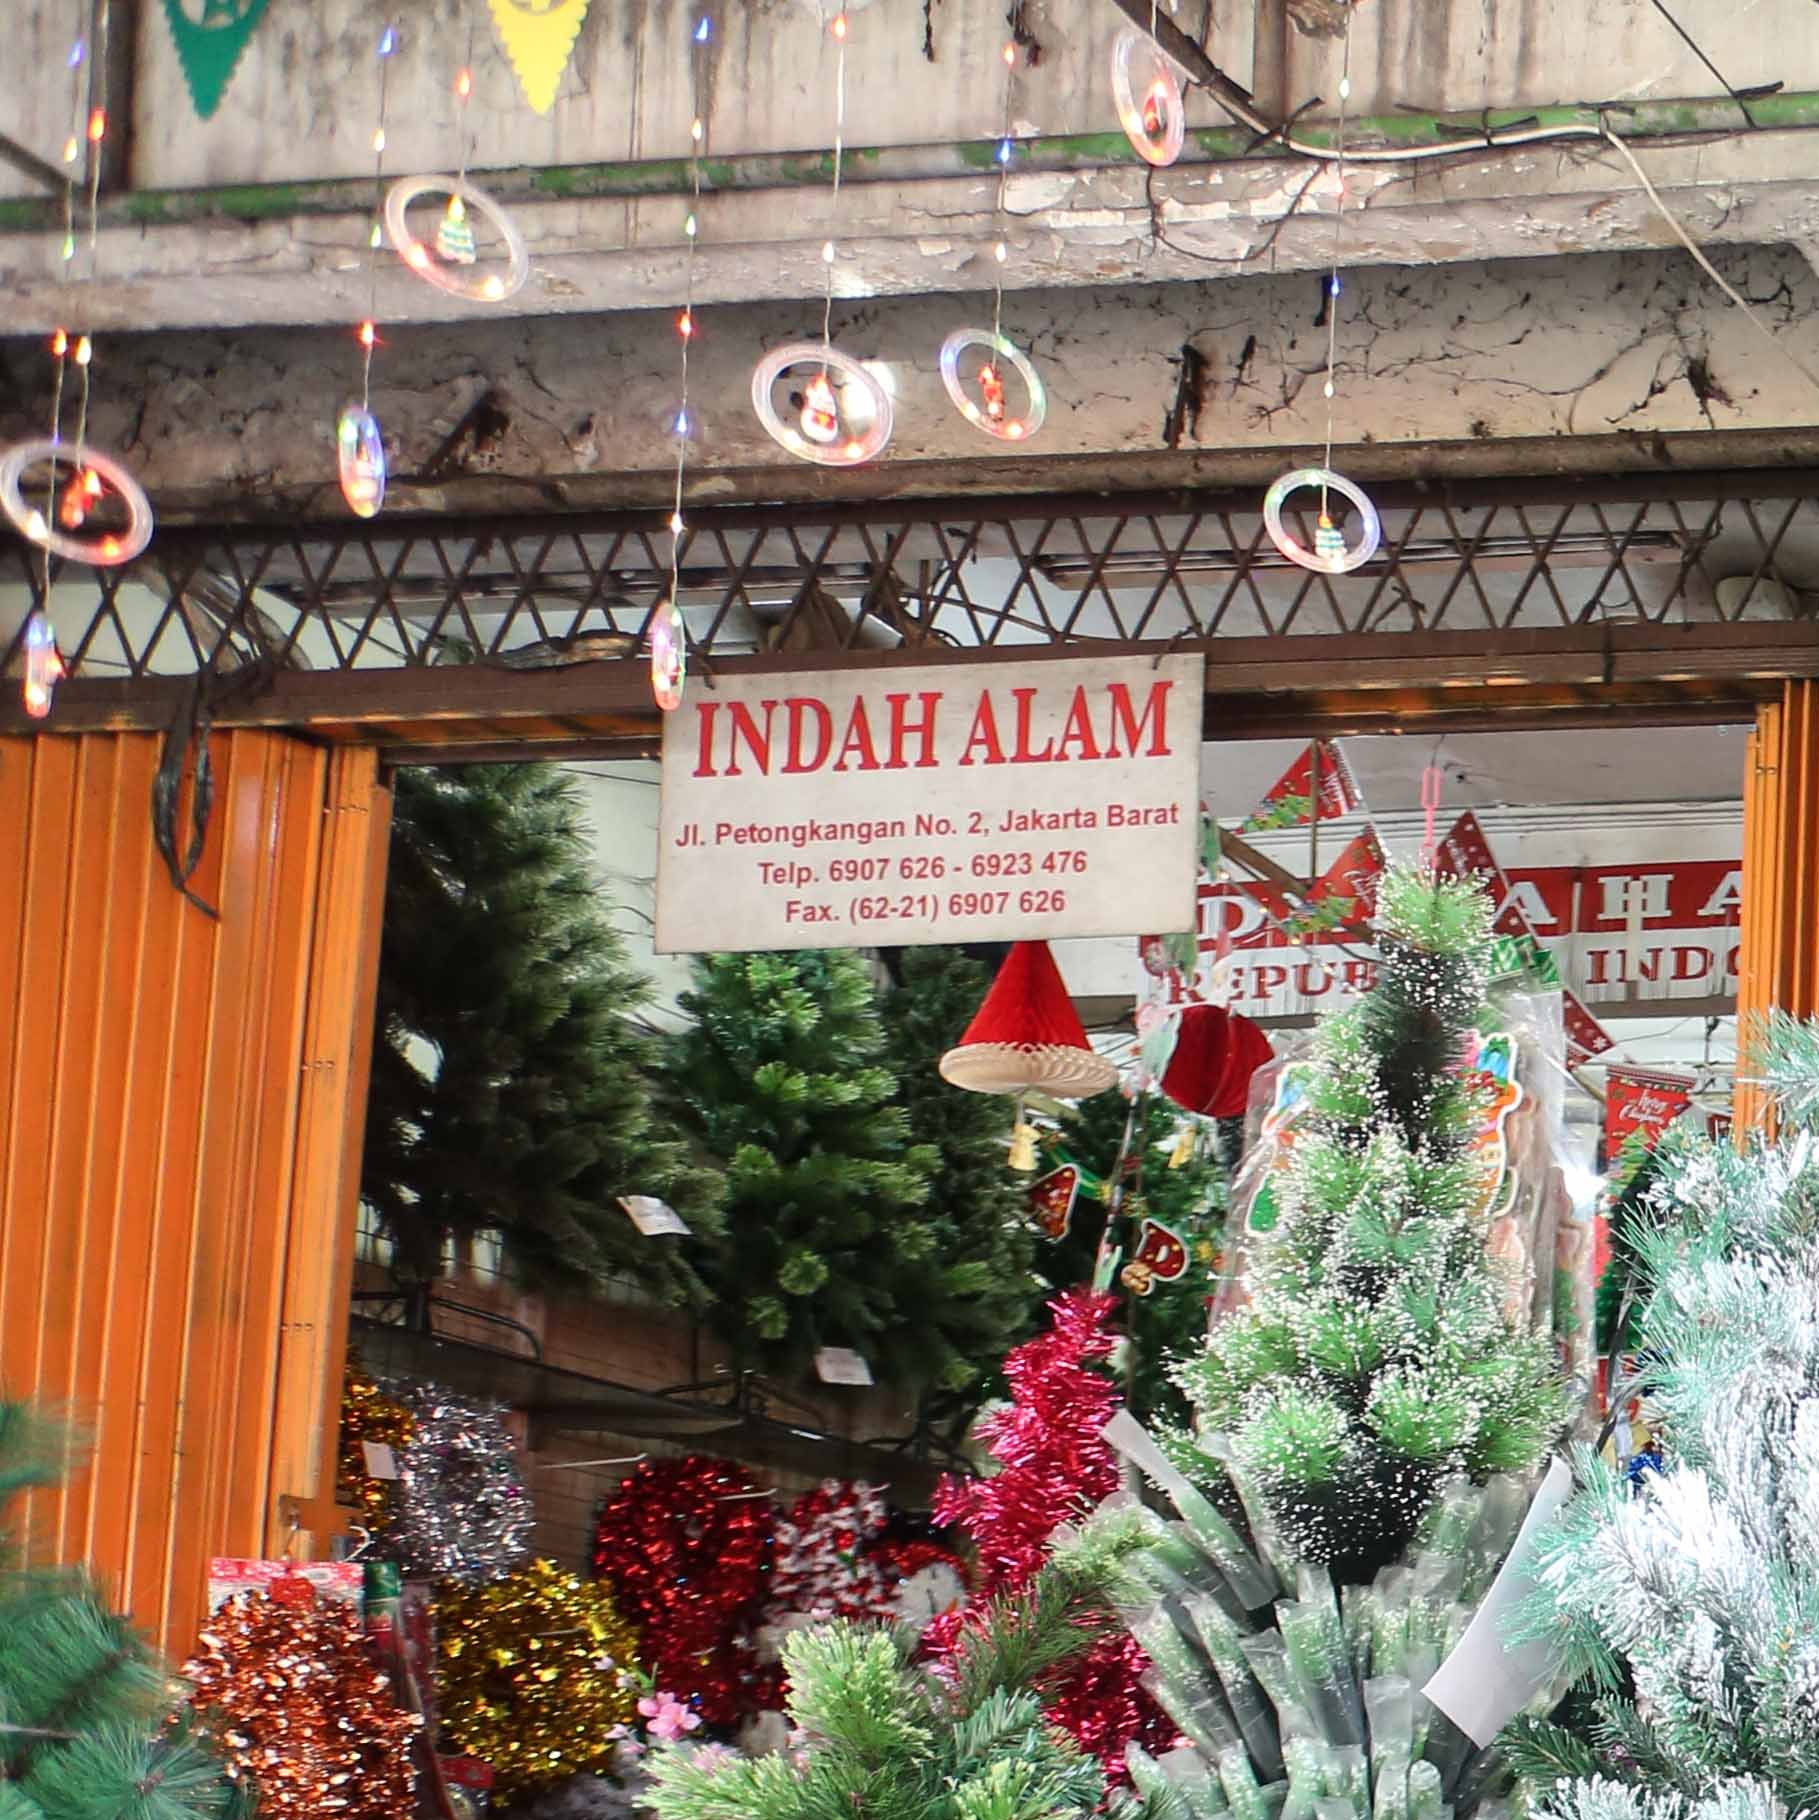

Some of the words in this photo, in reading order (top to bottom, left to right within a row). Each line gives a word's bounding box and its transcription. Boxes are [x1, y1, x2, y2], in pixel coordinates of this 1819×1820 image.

[692, 692, 944, 778] INDAH
[958, 680, 1174, 766] ALAM
[675, 824, 706, 848] Jl.
[715, 818, 905, 848] Petongkangan
[915, 813, 958, 836] No.
[967, 811, 990, 837] 2,
[998, 808, 1097, 833] Jakarta
[1107, 802, 1180, 827] Barat
[758, 862, 820, 889] Telp.
[828, 858, 891, 883] 6907
[899, 856, 945, 880] 626
[971, 852, 1033, 878] 6923
[1041, 849, 1088, 875] 476
[784, 899, 841, 924] Fax.
[849, 894, 940, 926] (62-21)
[949, 890, 1011, 917] 6907
[1019, 889, 1067, 914] 626
[1166, 960, 1381, 1005] REPUB
